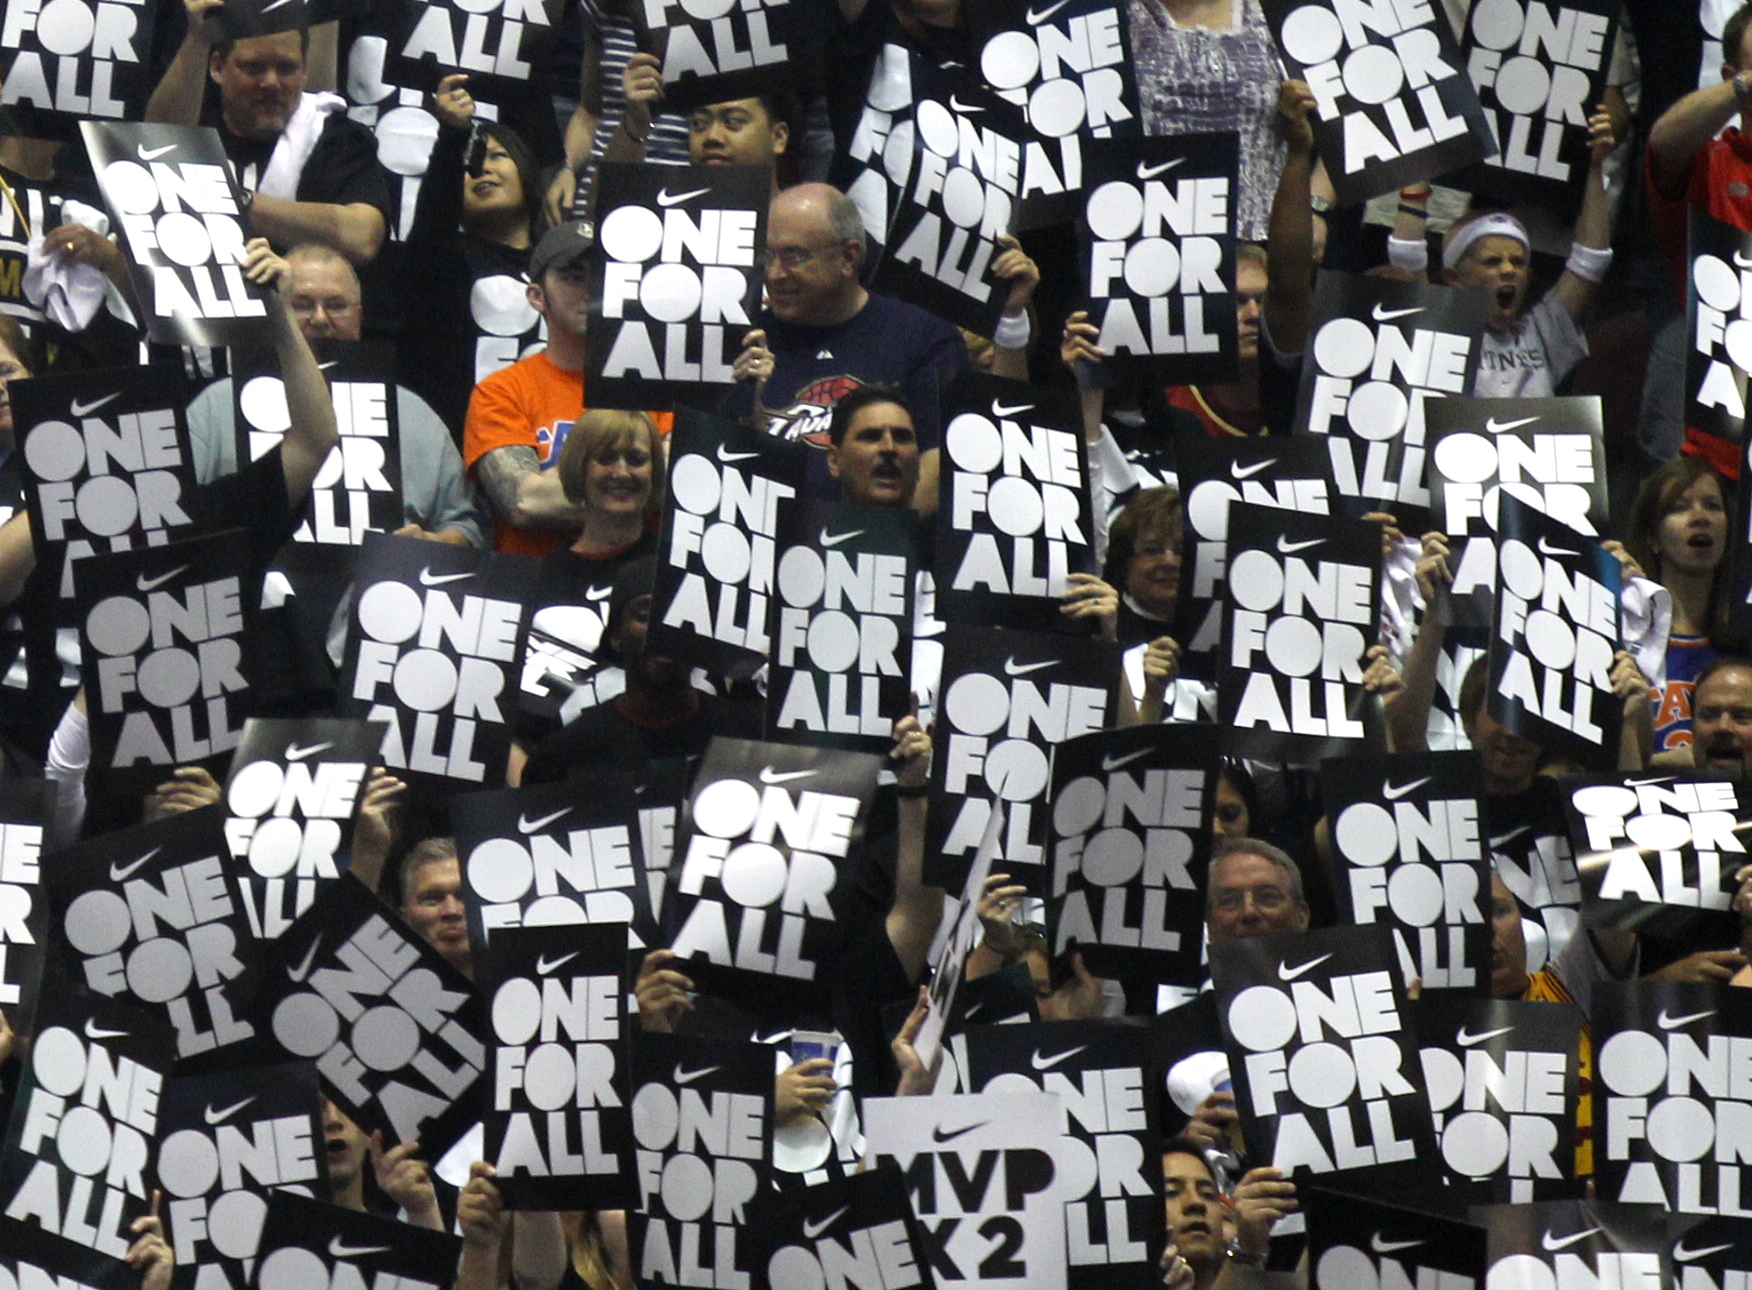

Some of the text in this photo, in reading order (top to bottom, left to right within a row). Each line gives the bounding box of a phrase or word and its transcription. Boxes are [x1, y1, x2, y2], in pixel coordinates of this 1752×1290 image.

[660, 10, 793, 85] ALL
[1301, 21, 1458, 122] FOR
[1343, 85, 1469, 175] ALL
[101, 160, 239, 214] ONE
[1087, 176, 1229, 241] ONE
[118, 212, 257, 267] FOR
[601, 205, 757, 267] ONE
[1091, 233, 1227, 298] FOR
[154, 265, 266, 321] ALL
[602, 261, 751, 326] FOR
[1094, 295, 1220, 357] ALL
[602, 320, 741, 383] ALL
[87, 577, 245, 657] ONE
[778, 548, 906, 615] ONE
[1500, 543, 1617, 640] ONE
[97, 632, 252, 715] FOR
[779, 605, 901, 678] FOR
[1498, 587, 1613, 696] FOR
[114, 696, 250, 772] ALL
[778, 667, 892, 741] ALL
[1497, 648, 1605, 749] ALL
[1574, 781, 1738, 819] ONE
[1585, 809, 1748, 852] FOR
[1599, 849, 1732, 910] ALL
[490, 974, 620, 1046] ONE
[1228, 969, 1401, 1052] ONE
[494, 1039, 620, 1111] FOR
[1243, 1030, 1415, 1116] FOR
[497, 1109, 614, 1178] ALL
[1272, 1100, 1418, 1180] ALL
[875, 1148, 1055, 1215] MVP
